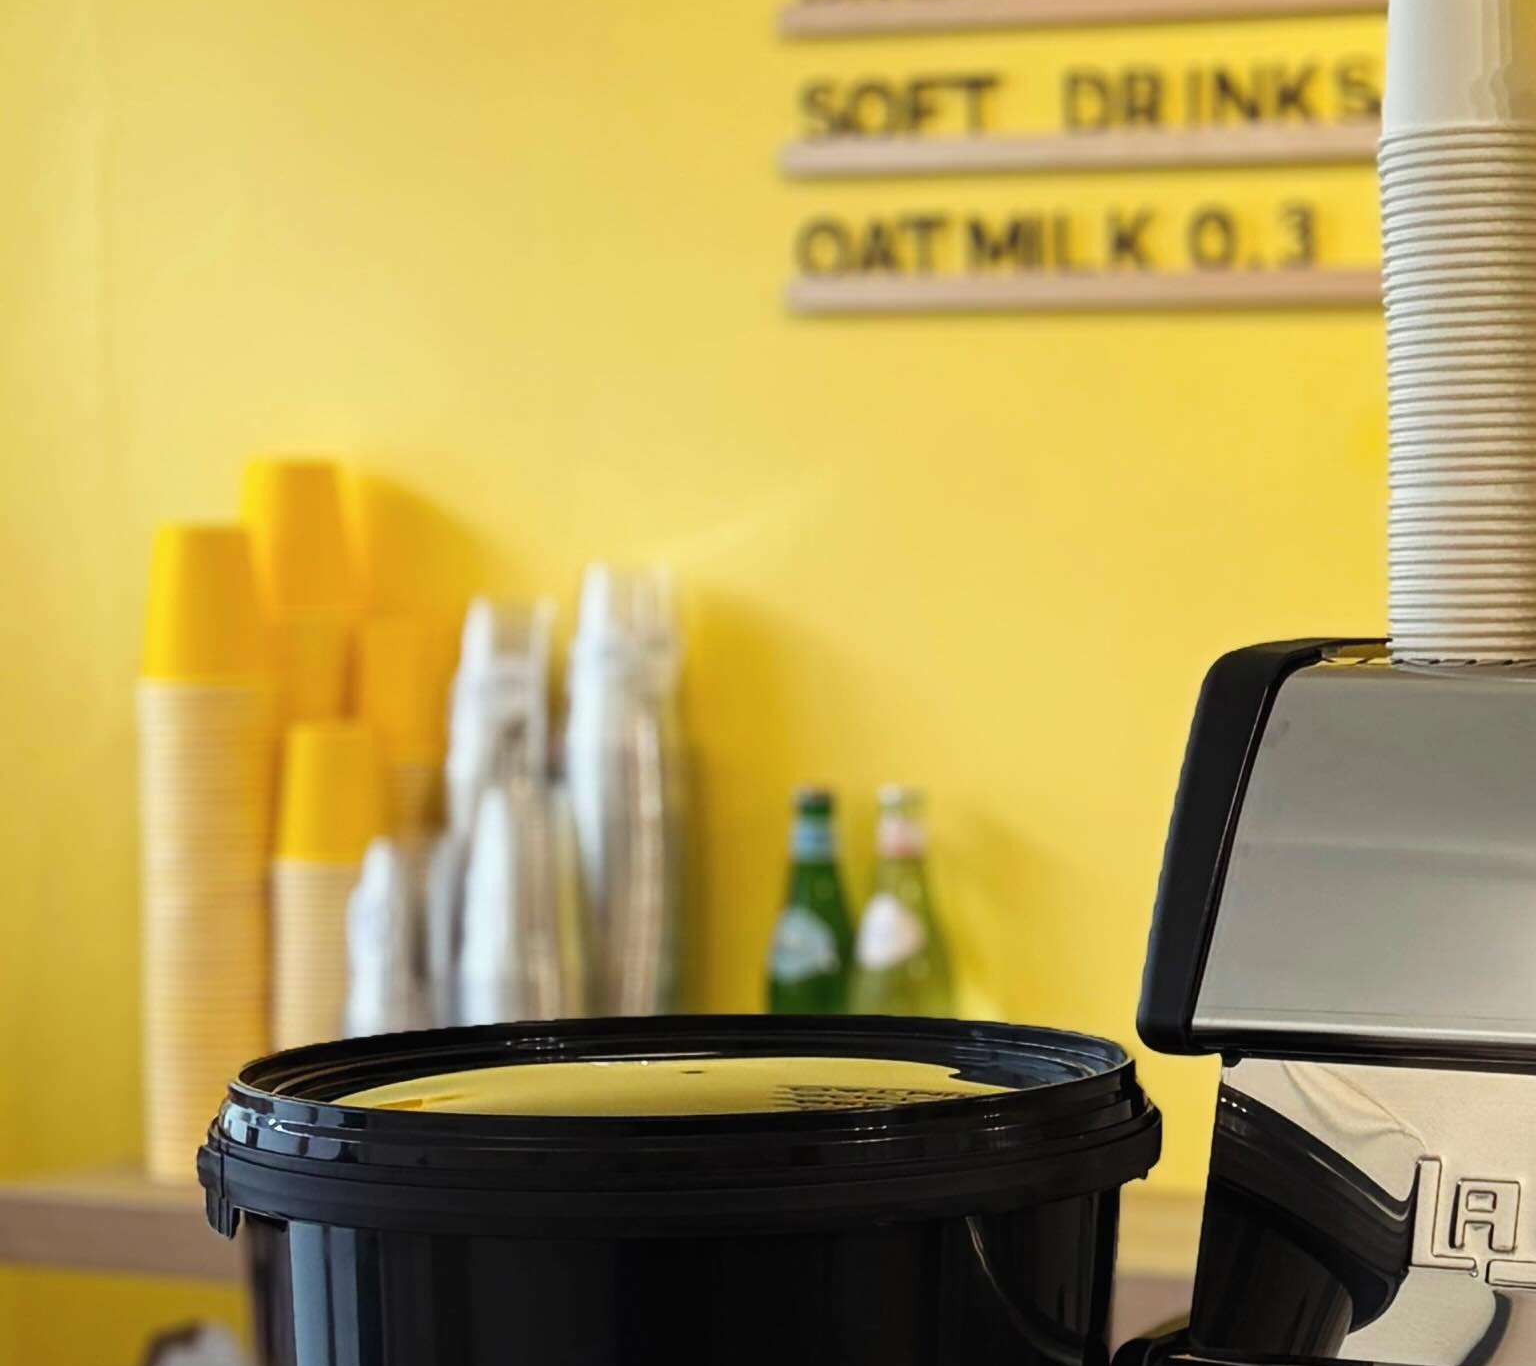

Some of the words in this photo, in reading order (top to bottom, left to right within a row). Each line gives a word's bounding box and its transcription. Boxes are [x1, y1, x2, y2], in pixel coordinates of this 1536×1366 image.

[801, 73, 1001, 139] SOFT
[1065, 60, 1382, 128] DRINKS
[1187, 203, 1317, 269] 0.3
